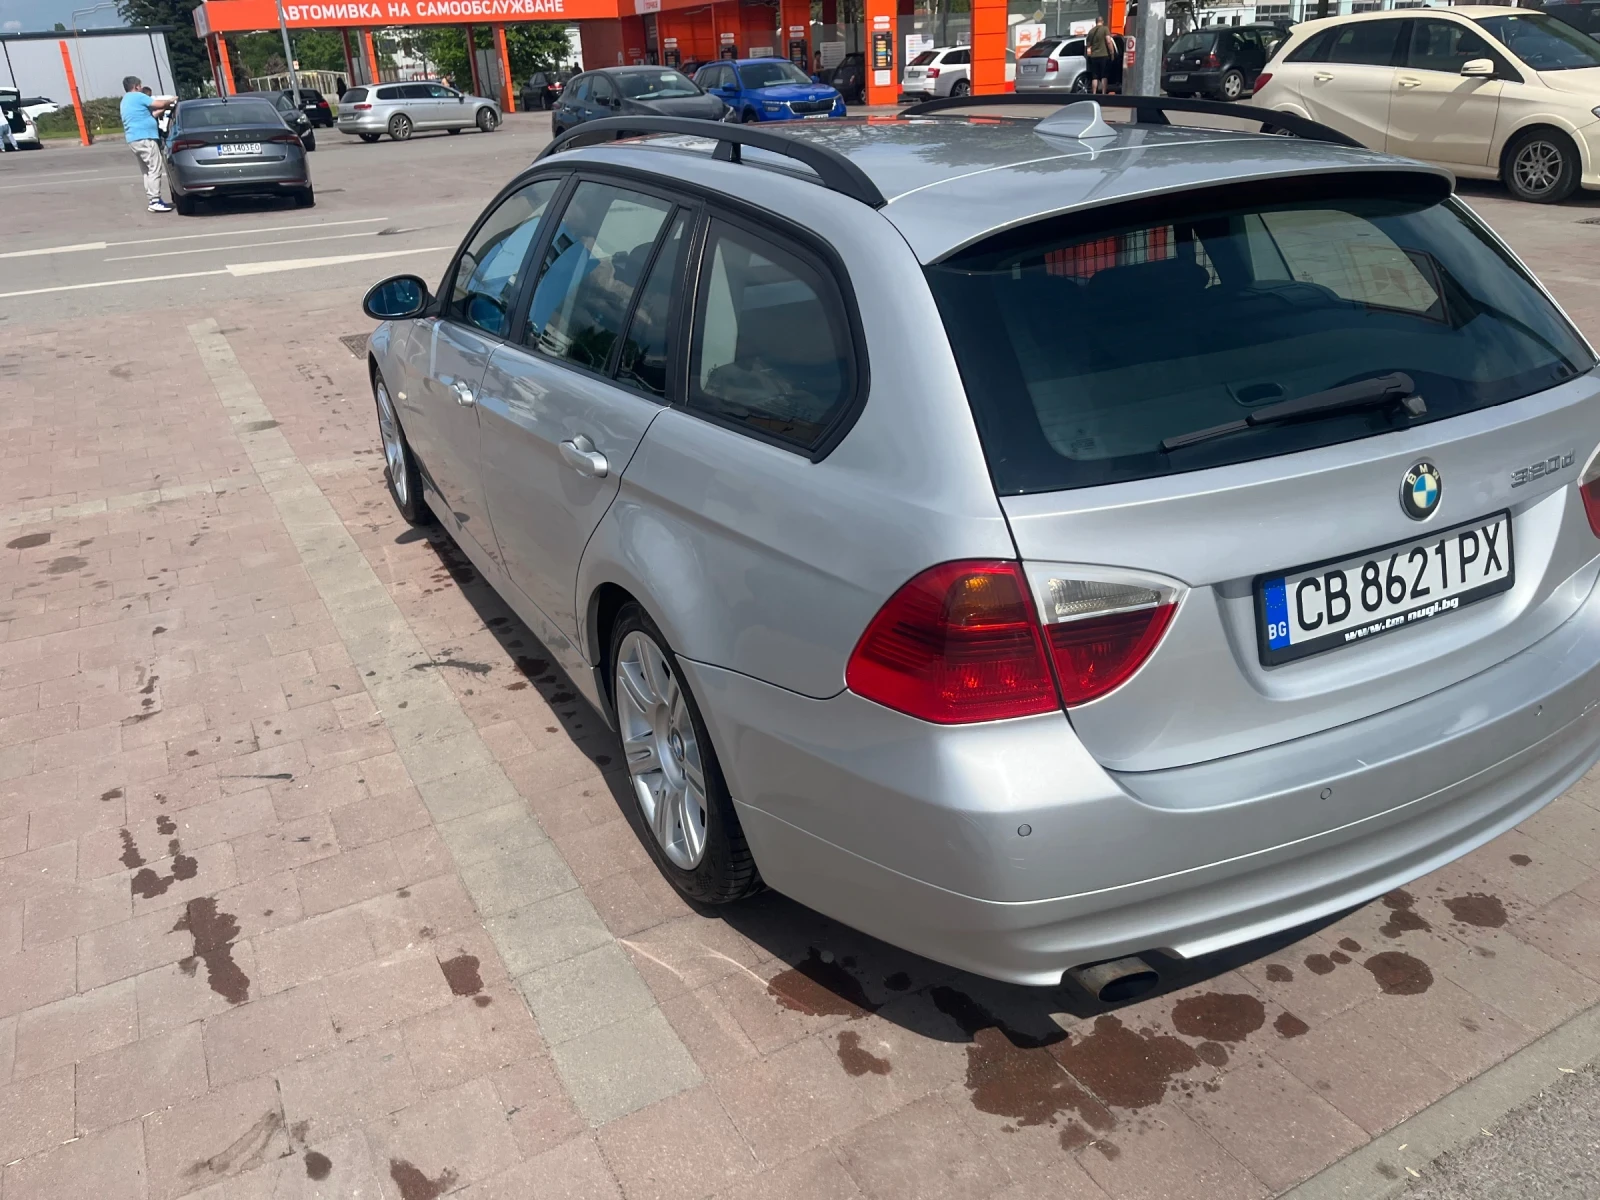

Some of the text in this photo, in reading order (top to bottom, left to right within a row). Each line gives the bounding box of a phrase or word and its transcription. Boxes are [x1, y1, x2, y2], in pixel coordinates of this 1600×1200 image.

[277, 0, 565, 20] АВТОМИВКА НА САМООБСЛУЖВАНЕ
[1407, 463, 1440, 485] BMW
[1510, 447, 1576, 489] 320d
[1295, 521, 1503, 632] CB 8621 PX
[1267, 620, 1287, 641] BG
